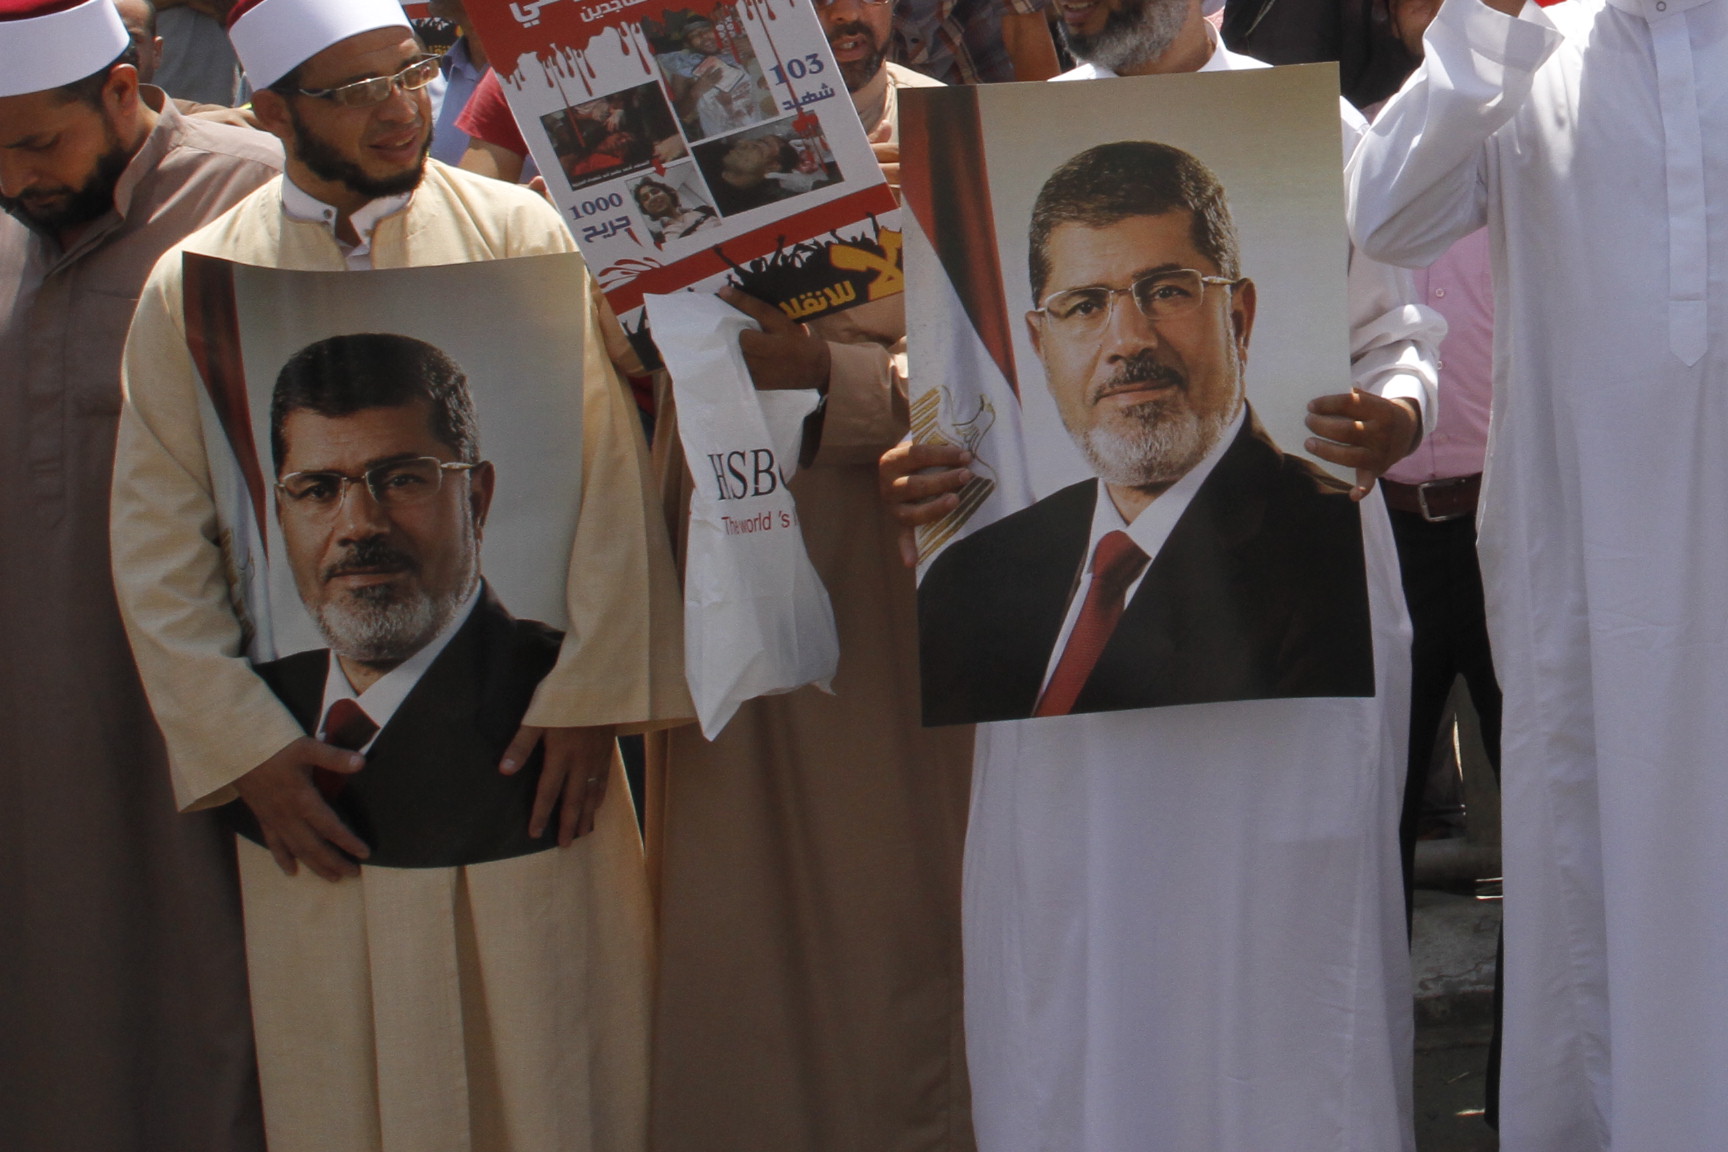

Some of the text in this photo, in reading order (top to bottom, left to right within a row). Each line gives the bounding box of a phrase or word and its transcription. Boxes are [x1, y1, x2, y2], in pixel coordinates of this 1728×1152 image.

[769, 53, 825, 87] 103
[781, 83, 836, 112] شهيد
[568, 193, 624, 221] 1000
[581, 212, 632, 244] جريح
[778, 225, 904, 321] لا للانقلا
[707, 448, 789, 501] HSB
